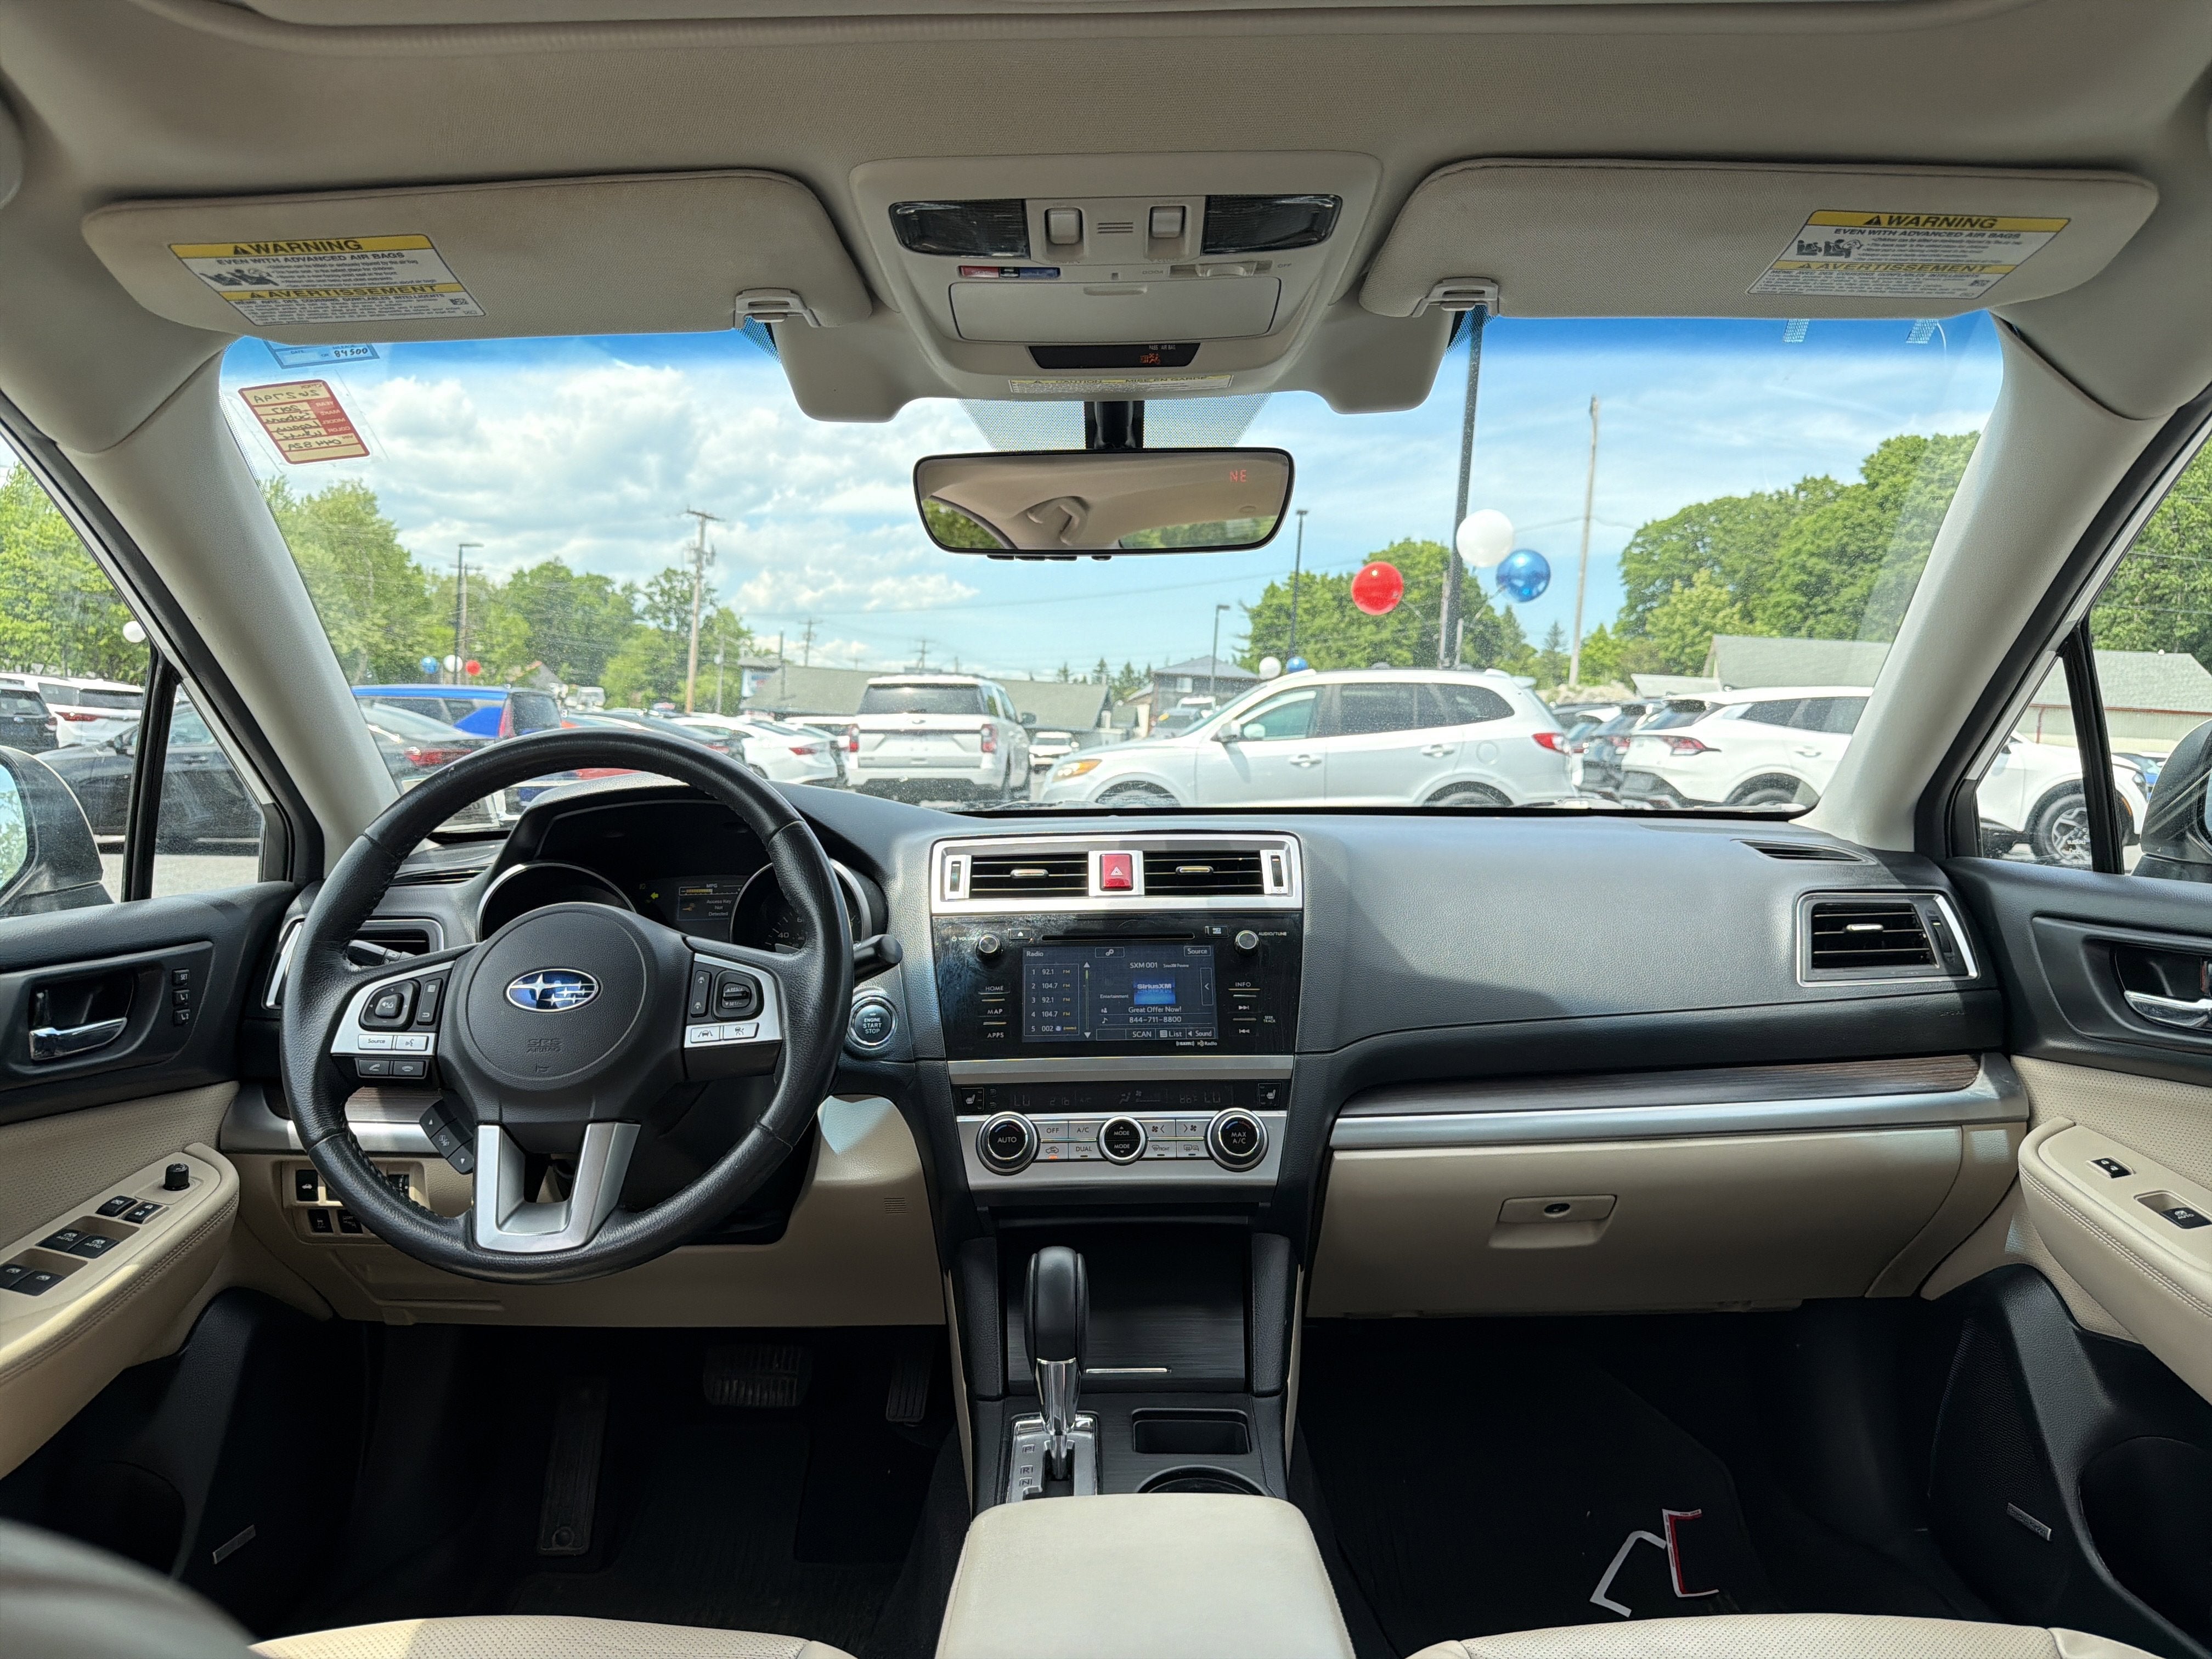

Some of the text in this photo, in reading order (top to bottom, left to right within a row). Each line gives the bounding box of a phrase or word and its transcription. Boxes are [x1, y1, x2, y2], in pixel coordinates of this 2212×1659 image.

[1888, 216, 1998, 229] WARNING
[247, 239, 363, 255] WARNING
[1815, 263, 1987, 273] AVERTISSEMENT
[268, 285, 437, 298] AVERTISSEMENT
[1229, 469, 1247, 483] NE
[527, 1038, 563, 1046] SRS
